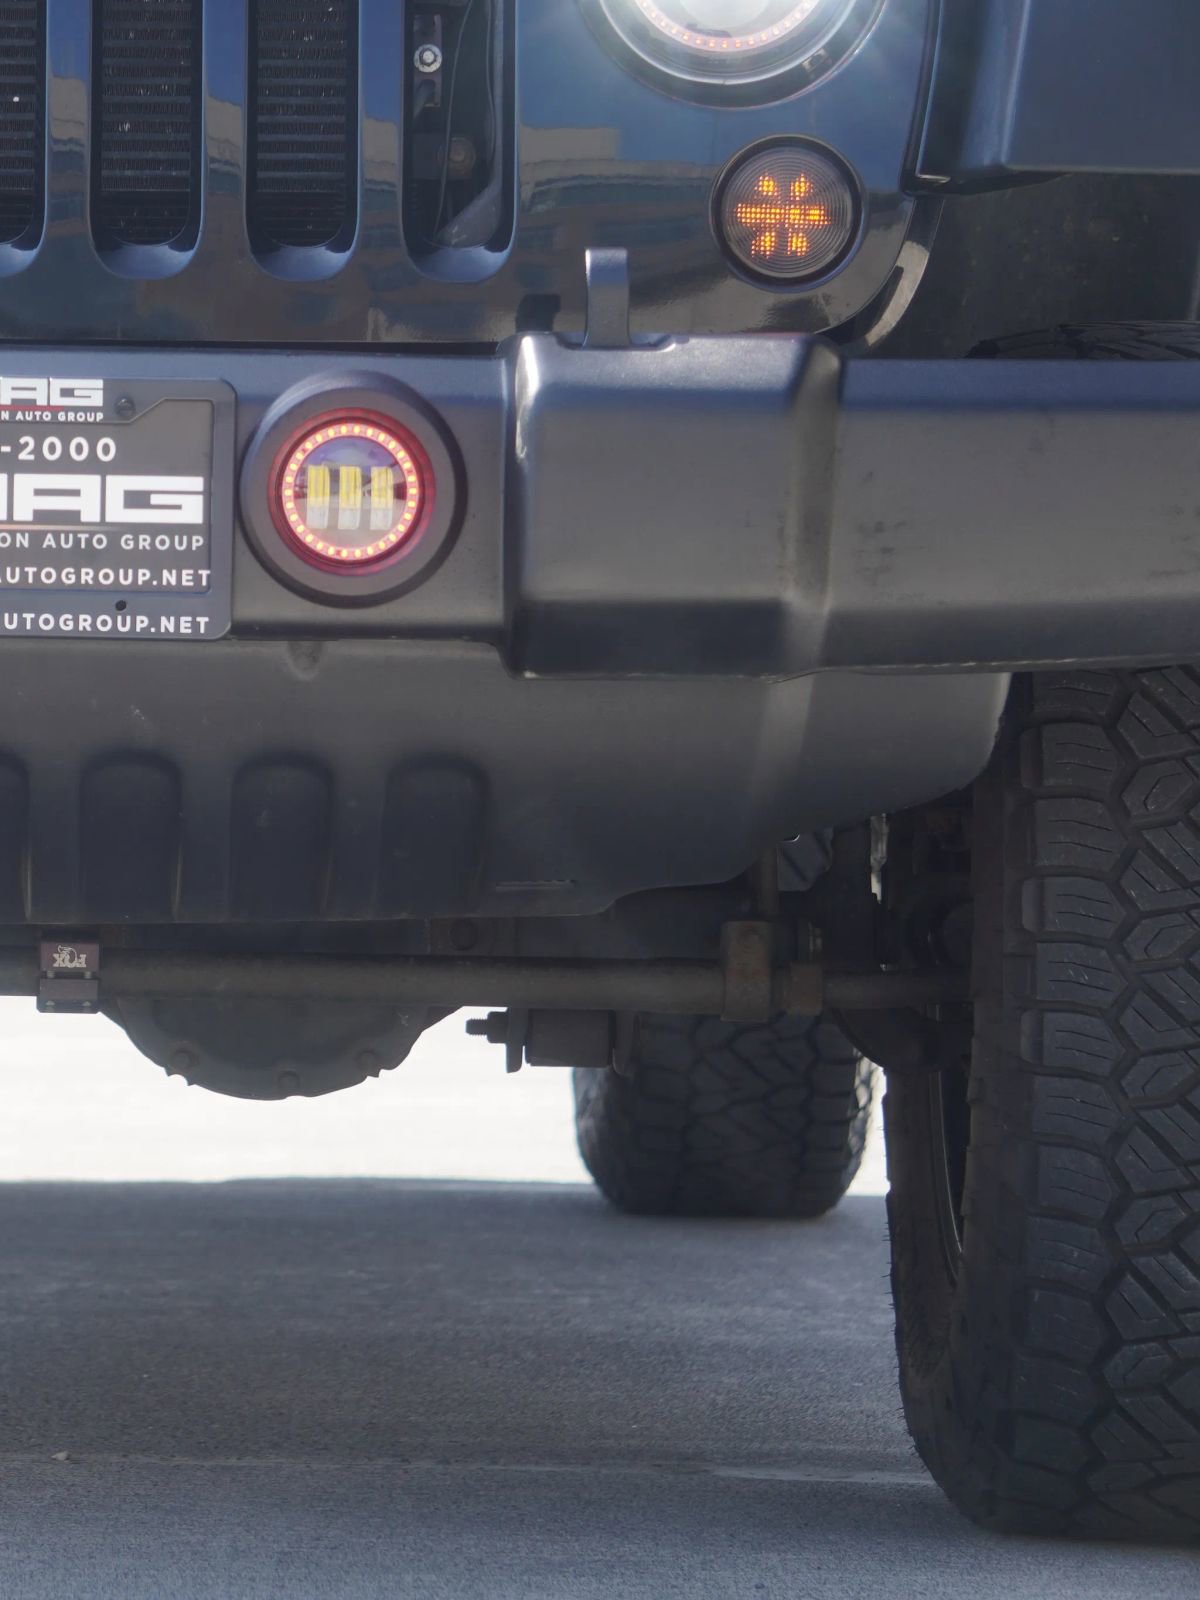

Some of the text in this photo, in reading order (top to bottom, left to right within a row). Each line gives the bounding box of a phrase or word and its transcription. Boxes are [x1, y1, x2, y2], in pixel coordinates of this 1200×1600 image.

[15, 410, 52, 422] AUTO
[57, 411, 104, 422] GROUP
[42, 533, 108, 551] AUTO
[120, 534, 205, 552] GROUP
